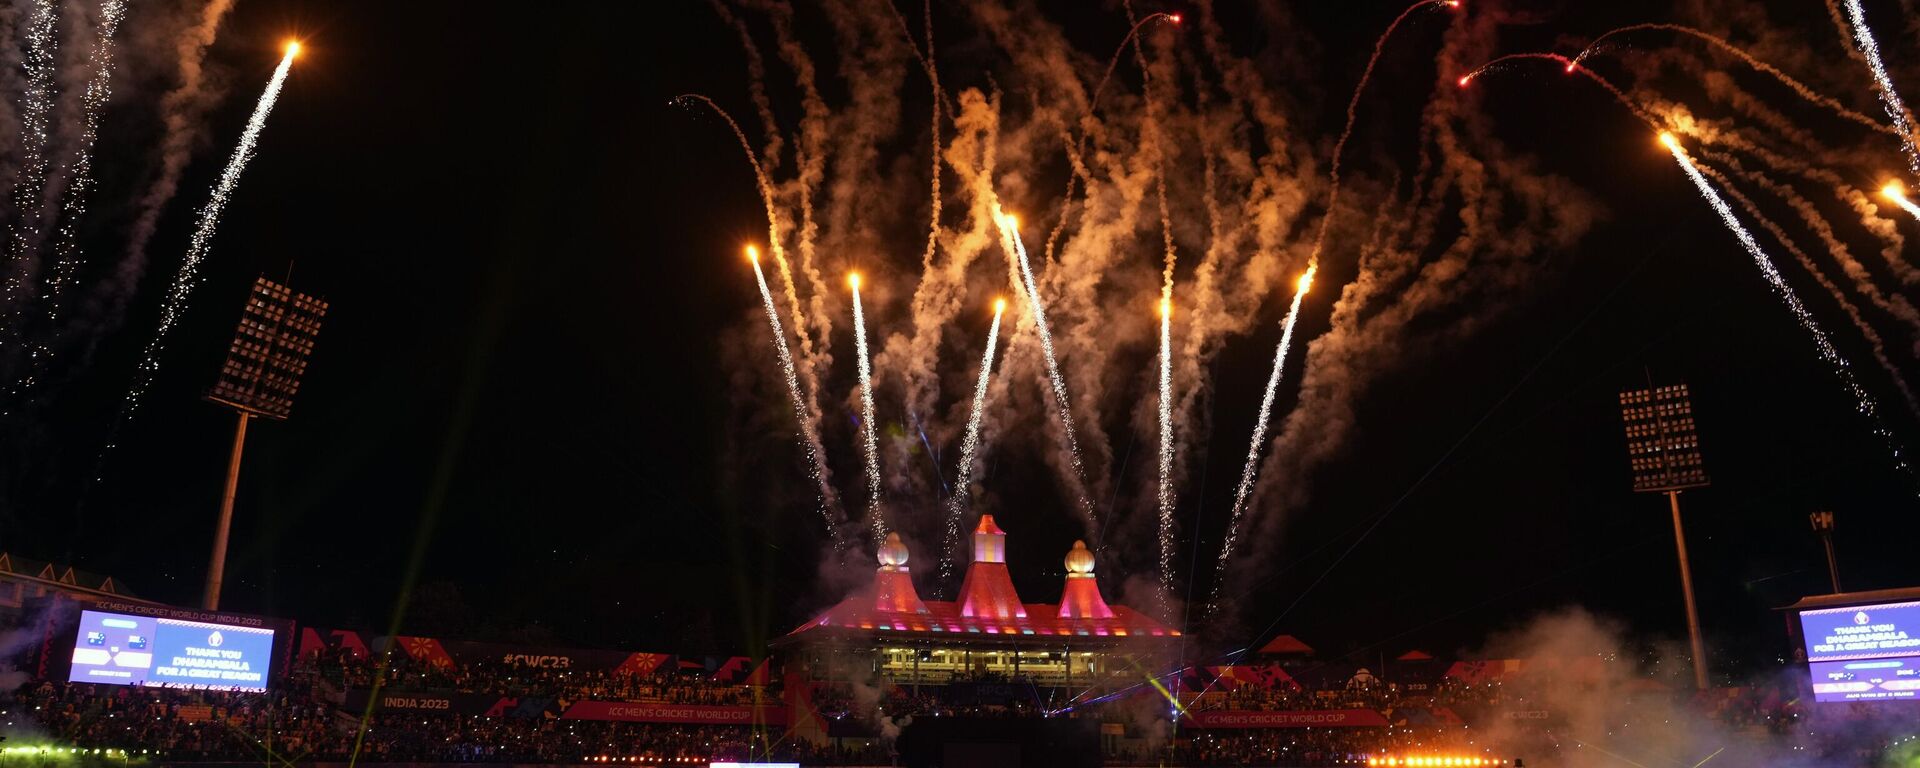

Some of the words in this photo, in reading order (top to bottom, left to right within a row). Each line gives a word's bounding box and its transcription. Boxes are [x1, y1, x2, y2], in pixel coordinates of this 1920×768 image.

[135, 606, 168, 616] CRICKET
[170, 610, 199, 619] WORLD
[217, 615, 240, 624] INDIA
[241, 617, 262, 626] 2023
[1834, 626, 1871, 634] THANK
[1871, 624, 1895, 632] YOU
[1844, 641, 1878, 650] GREAT
[185, 647, 220, 658] THANK
[221, 650, 242, 660] YOU
[156, 666, 178, 676] FOR
[179, 668, 188, 677] A
[188, 669, 222, 679] GREAT
[222, 671, 261, 681] SEASON
[384, 697, 418, 708] INDIA
[420, 698, 449, 709] 2023
[608, 707, 624, 716] ICC
[624, 708, 654, 717] MEN'S
[655, 708, 694, 718] CRICKET
[696, 710, 730, 720] WORLD
[731, 710, 750, 720] CUP
[1205, 716, 1218, 724] ICC
[1219, 715, 1248, 724] MEN'S
[1248, 714, 1289, 724] CRICKET
[1290, 714, 1326, 723] WORLD
[1326, 713, 1346, 722] CUP
